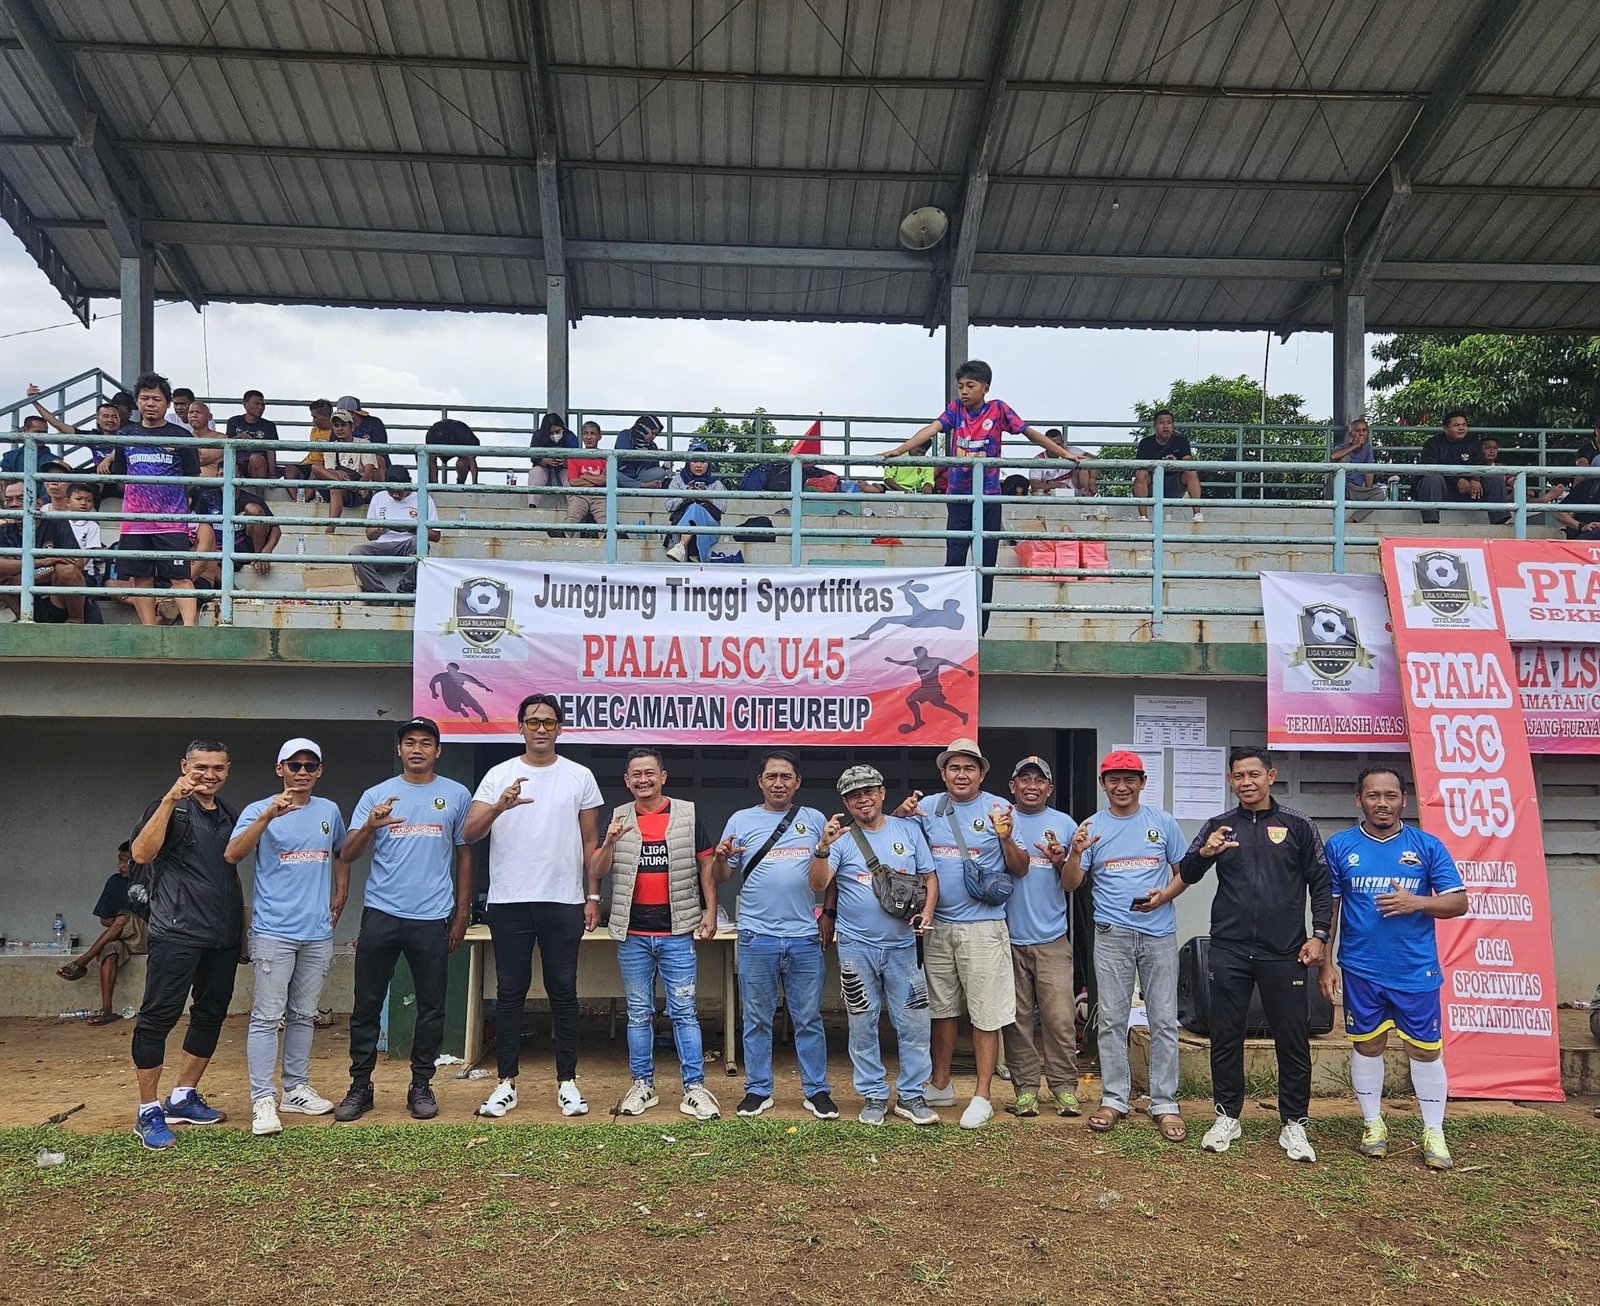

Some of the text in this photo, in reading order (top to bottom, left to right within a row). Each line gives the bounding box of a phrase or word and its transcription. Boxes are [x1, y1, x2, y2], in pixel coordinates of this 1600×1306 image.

[534, 573, 894, 621] Jungjung Tinggi Sportifitas
[582, 634, 845, 681] PIALA LSC U45
[1307, 647, 1355, 657] LIGA SILATURAHMI
[1411, 661, 1507, 700] PIALA
[1561, 646, 1600, 689] LS
[555, 695, 871, 730] EKECAMATAN CITEUREUP
[1286, 716, 1404, 733] TERIMA KASIH ATAS
[1435, 724, 1499, 764] LSC
[1445, 786, 1510, 829] U45
[638, 856, 669, 866] ATURA
[642, 845, 667, 855] LIGA
[1457, 861, 1516, 883] SELAMAT
[1467, 894, 1532, 916] RTANDING
[1477, 939, 1513, 962] JAGA
[1454, 971, 1541, 997] SPORTIVITAS
[1449, 1004, 1552, 1032] PERTANDINGAN
